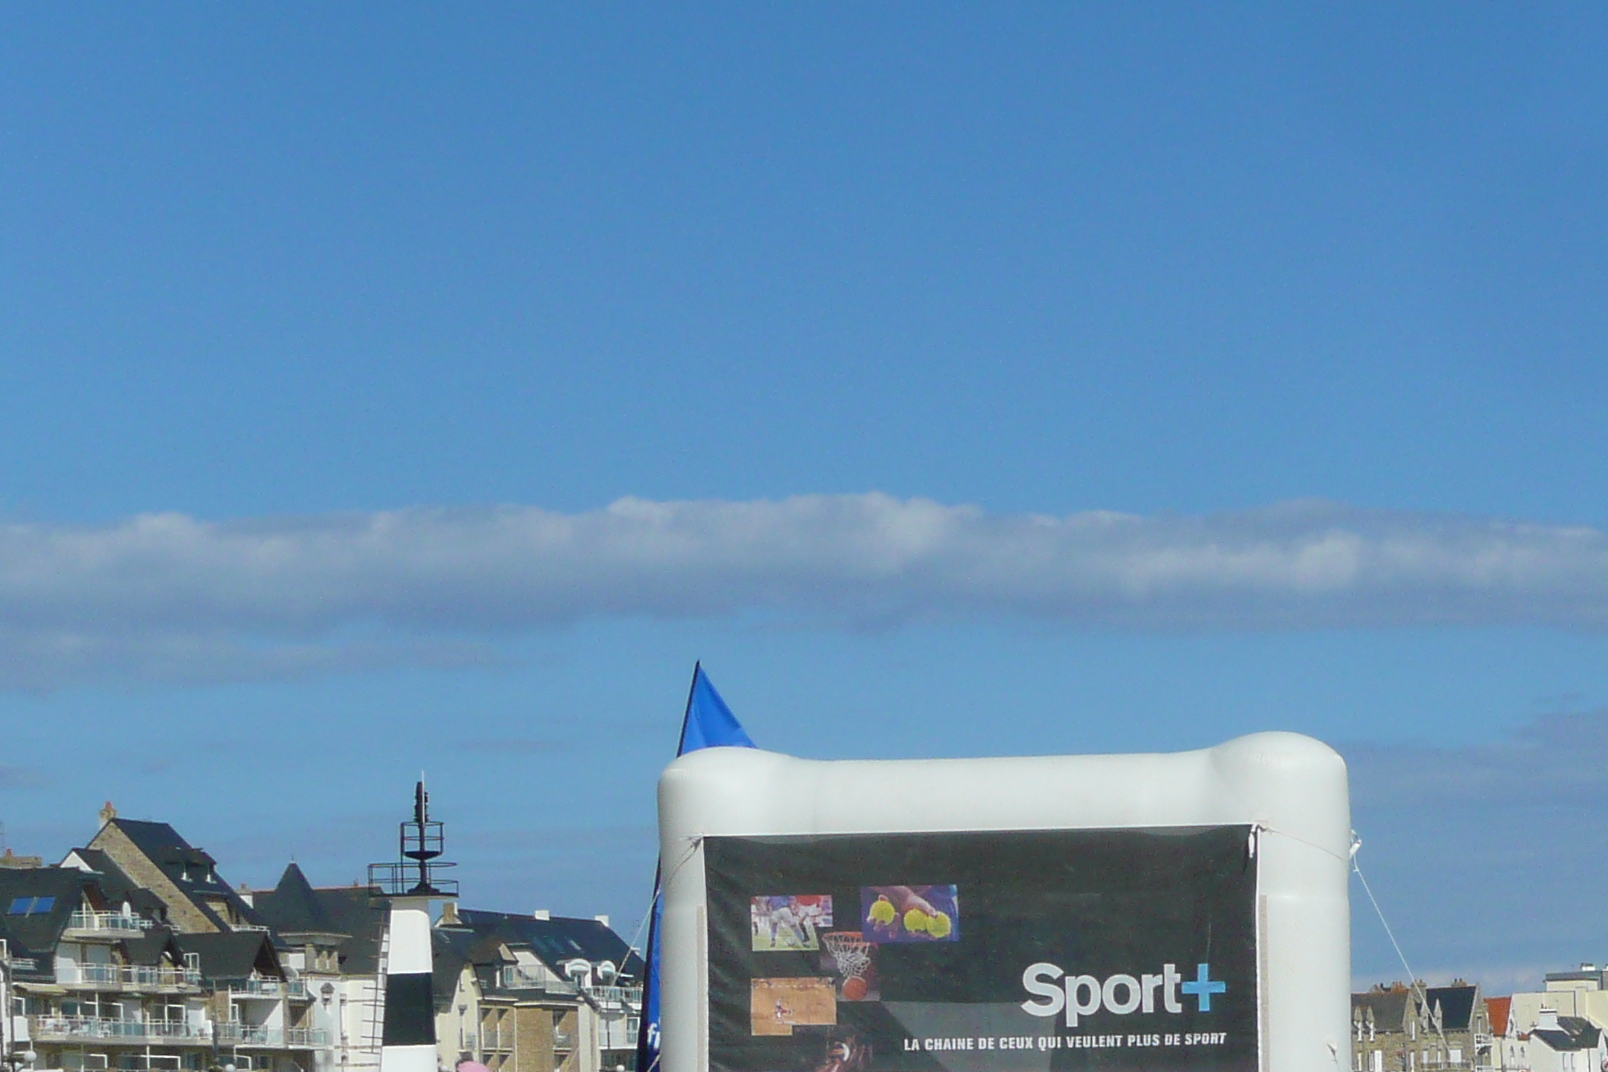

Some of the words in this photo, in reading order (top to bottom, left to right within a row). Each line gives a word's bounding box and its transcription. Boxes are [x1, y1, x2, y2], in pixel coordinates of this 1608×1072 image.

[1020, 962, 1227, 1028] Sport+
[904, 1038, 920, 1050] LA
[924, 1037, 975, 1050] CHAINE
[977, 1037, 996, 1050] DE
[999, 1036, 1034, 1050] CEUX
[1038, 1036, 1061, 1051] QUI
[1066, 1035, 1124, 1049] VEULENT
[1127, 1034, 1160, 1047] PLUS
[1164, 1033, 1181, 1046] DE
[1184, 1032, 1228, 1046] SPORT
